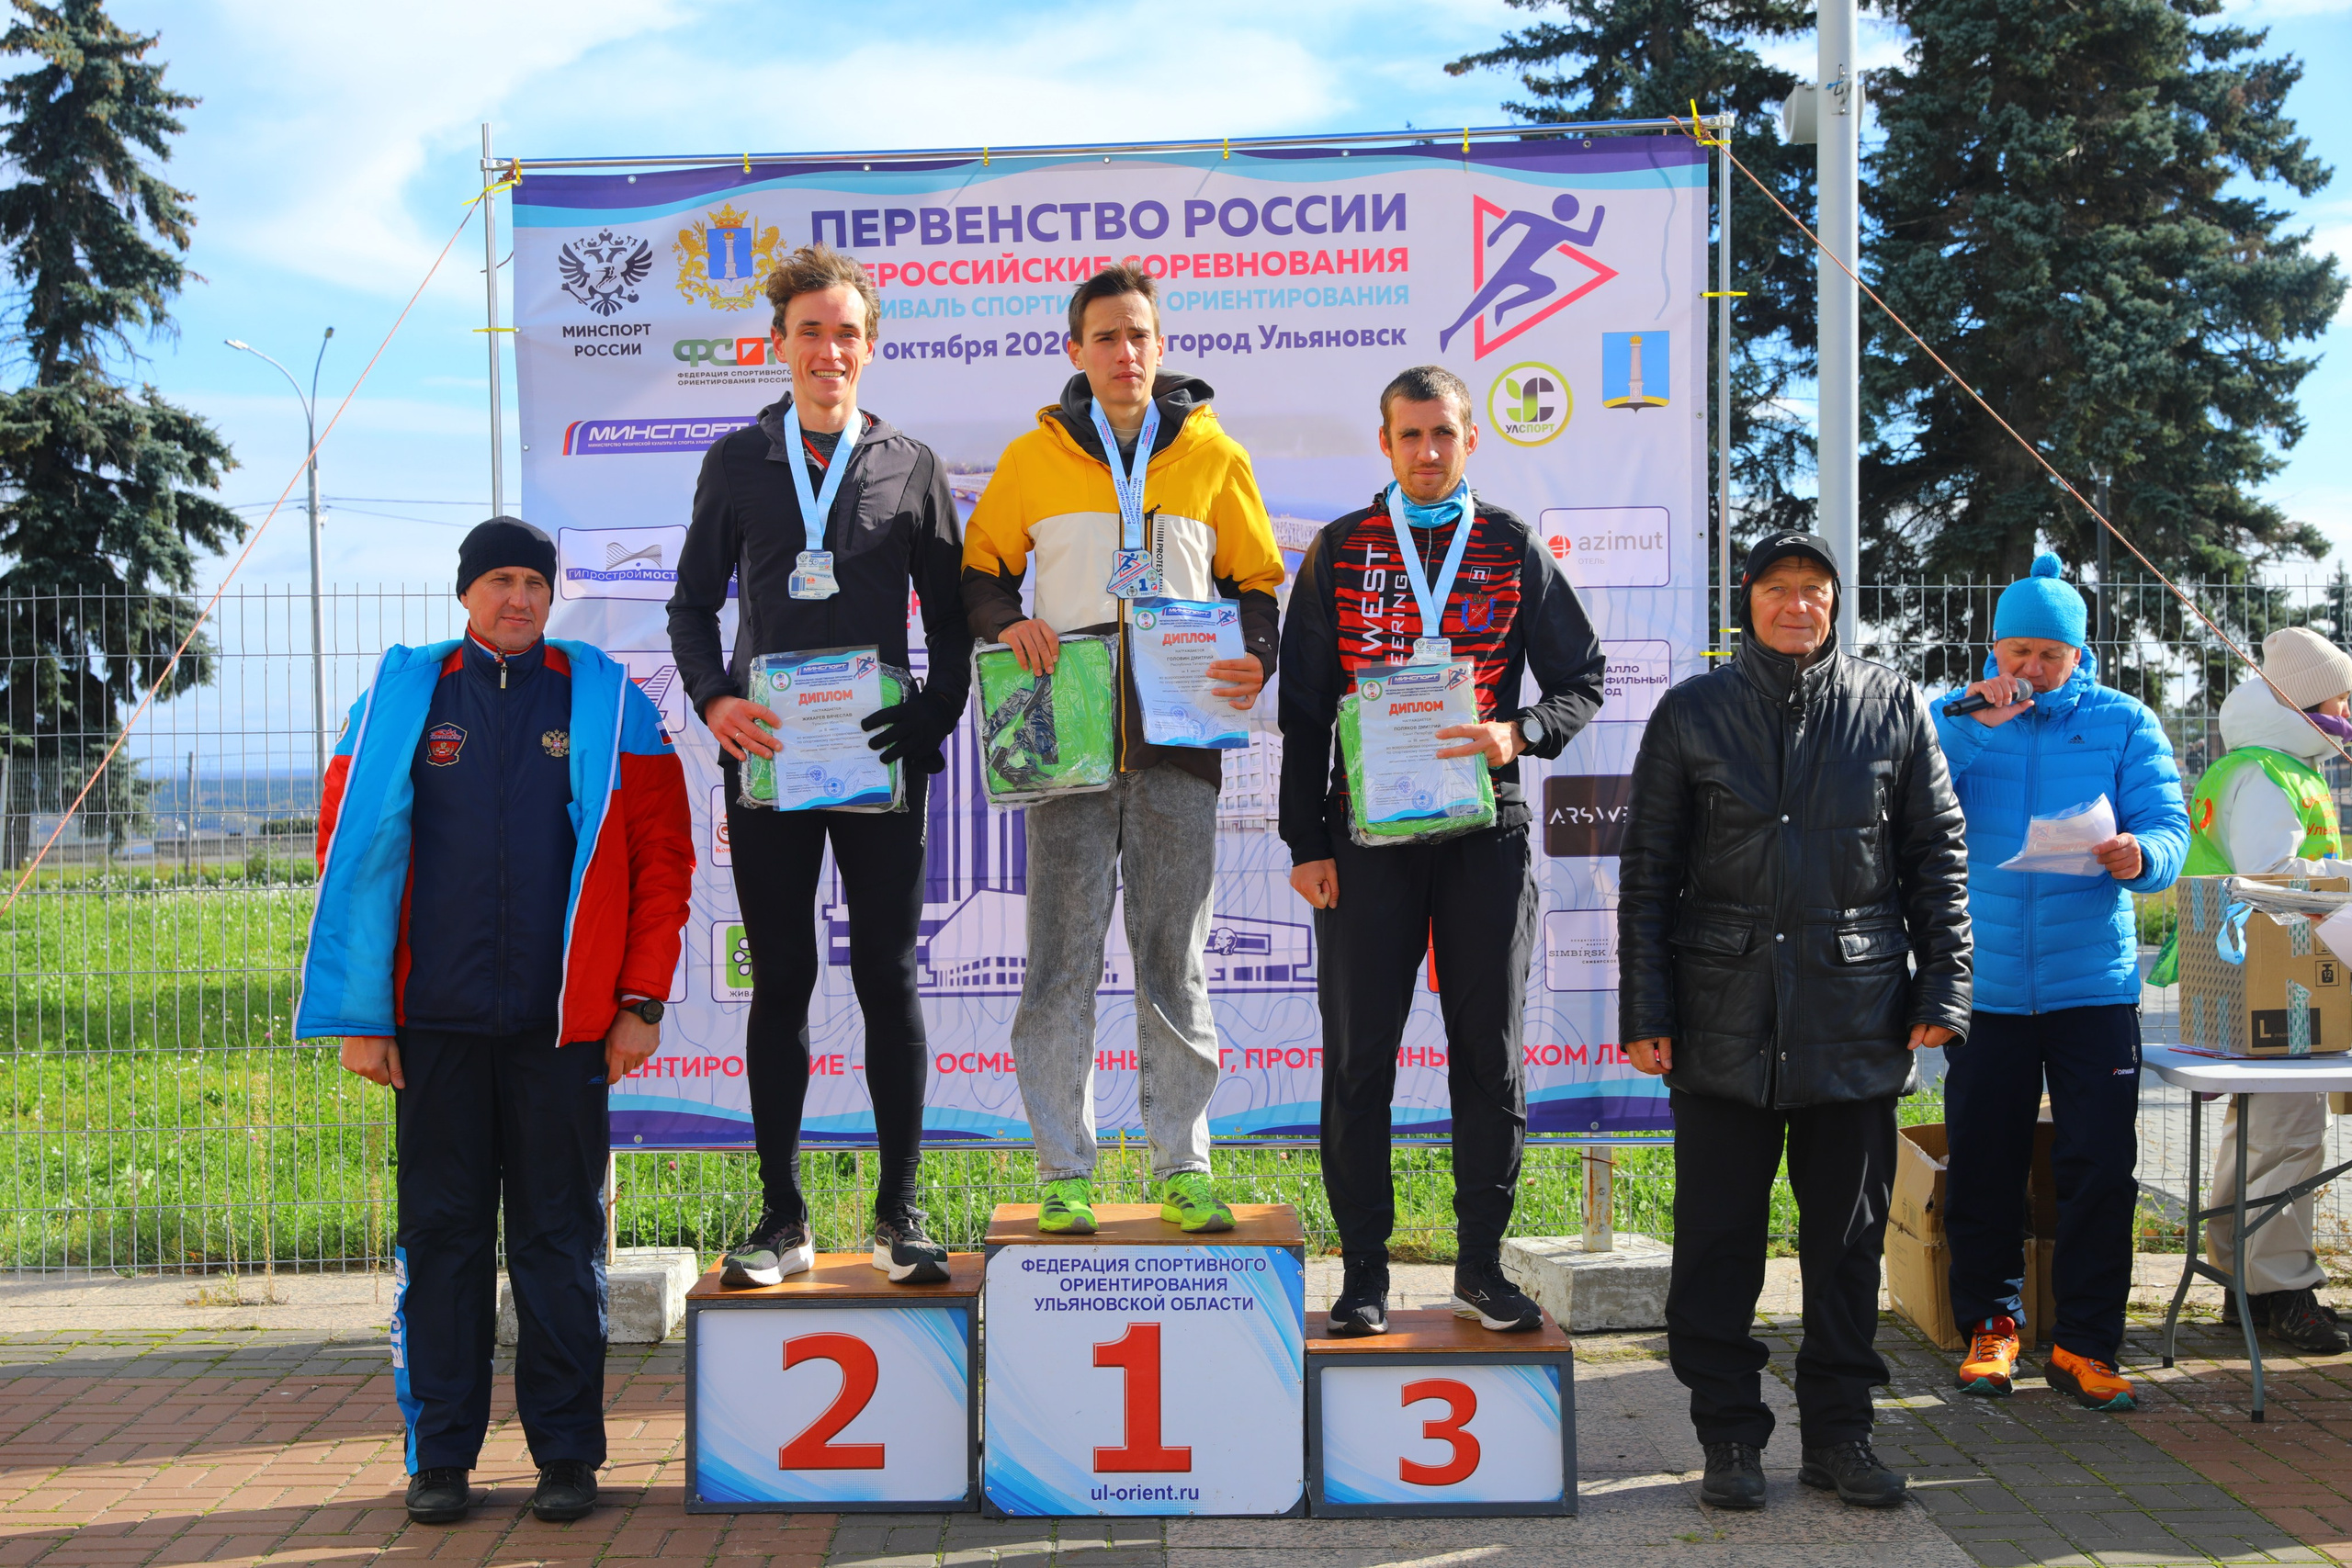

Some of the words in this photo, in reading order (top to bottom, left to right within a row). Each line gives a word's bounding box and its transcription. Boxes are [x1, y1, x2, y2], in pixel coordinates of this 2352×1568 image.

[811, 200, 1170, 249] ПЕРВЕНСТВО
[1184, 193, 1407, 238] РОССИИ
[862, 253, 1112, 288] ЕРОССИЙСКИЕ
[879, 296, 966, 320] ИВАЛЬ
[1166, 284, 1409, 311] ОРИЕНТИРОВАНИЯ
[562, 323, 650, 338] МИНСПОРТ
[574, 343, 642, 356] РОССИИ
[883, 333, 998, 365] октября
[1168, 332, 1251, 357] город
[1258, 323, 1407, 350] Ульяновск
[730, 368, 791, 377] СПОРТИВНОГО
[588, 422, 750, 442] МИНСПОРТ
[1505, 423, 1555, 434] УЛСПОРТ
[1578, 530, 1663, 551] azimut
[1139, 578, 1148, 591] 1
[1361, 543, 1389, 652] WEST
[1391, 575, 1408, 666] EERING
[1162, 632, 1217, 646] ДИПЛОМ
[1605, 674, 1668, 685] ФИЛЬНЫЙ
[798, 689, 853, 706] ДИПЛОМ
[1389, 700, 1444, 716] ДИПЛОМ
[2260, 1020, 2272, 1038] L
[1523, 1043, 1587, 1066] ХОМ
[1021, 1258, 1129, 1274] ФЕДЕРАЦИЯ
[1135, 1258, 1267, 1272] СПОРТИВНОГО
[1060, 1278, 1228, 1292] ОРИЕНТИРОВАНИЯ
[1035, 1294, 1165, 1312] УЛЬЯНОВСКОЙ
[1170, 1297, 1254, 1311] ОБЛАСТИ
[778, 1330, 886, 1470] 2
[1093, 1322, 1192, 1473] 1
[1399, 1377, 1482, 1486] 3
[1091, 1484, 1199, 1500] ul-orient.ru
